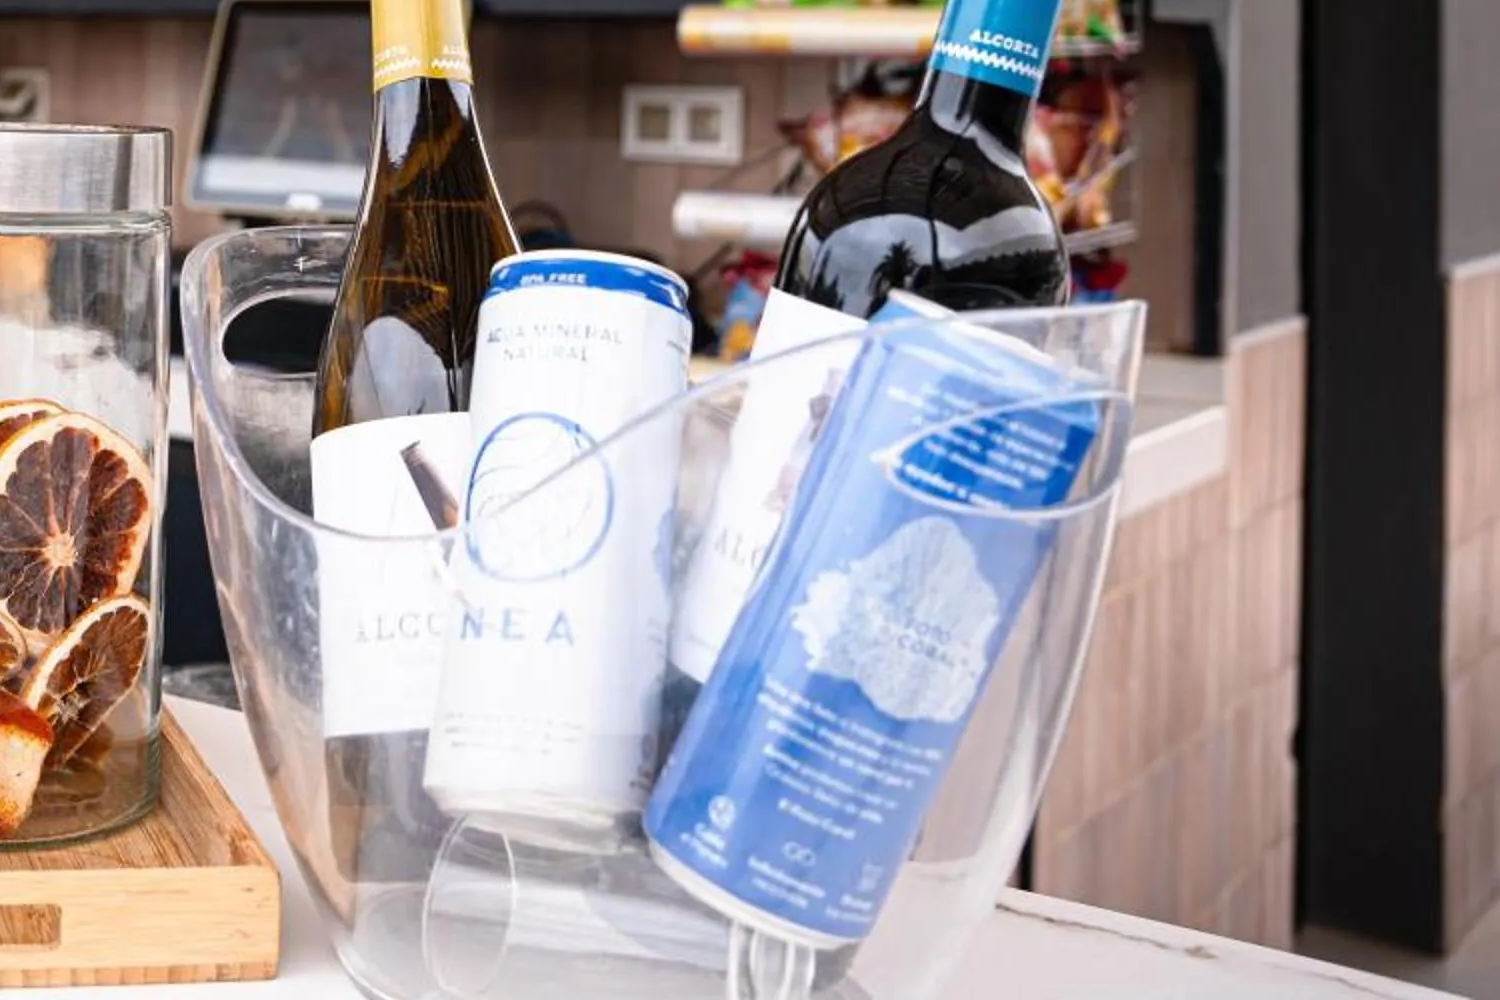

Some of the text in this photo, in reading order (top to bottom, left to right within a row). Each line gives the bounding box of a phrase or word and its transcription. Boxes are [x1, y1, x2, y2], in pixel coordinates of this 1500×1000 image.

[969, 29, 1039, 59] ALCORTA
[549, 273, 588, 285] FREE
[459, 606, 575, 648] NEA
